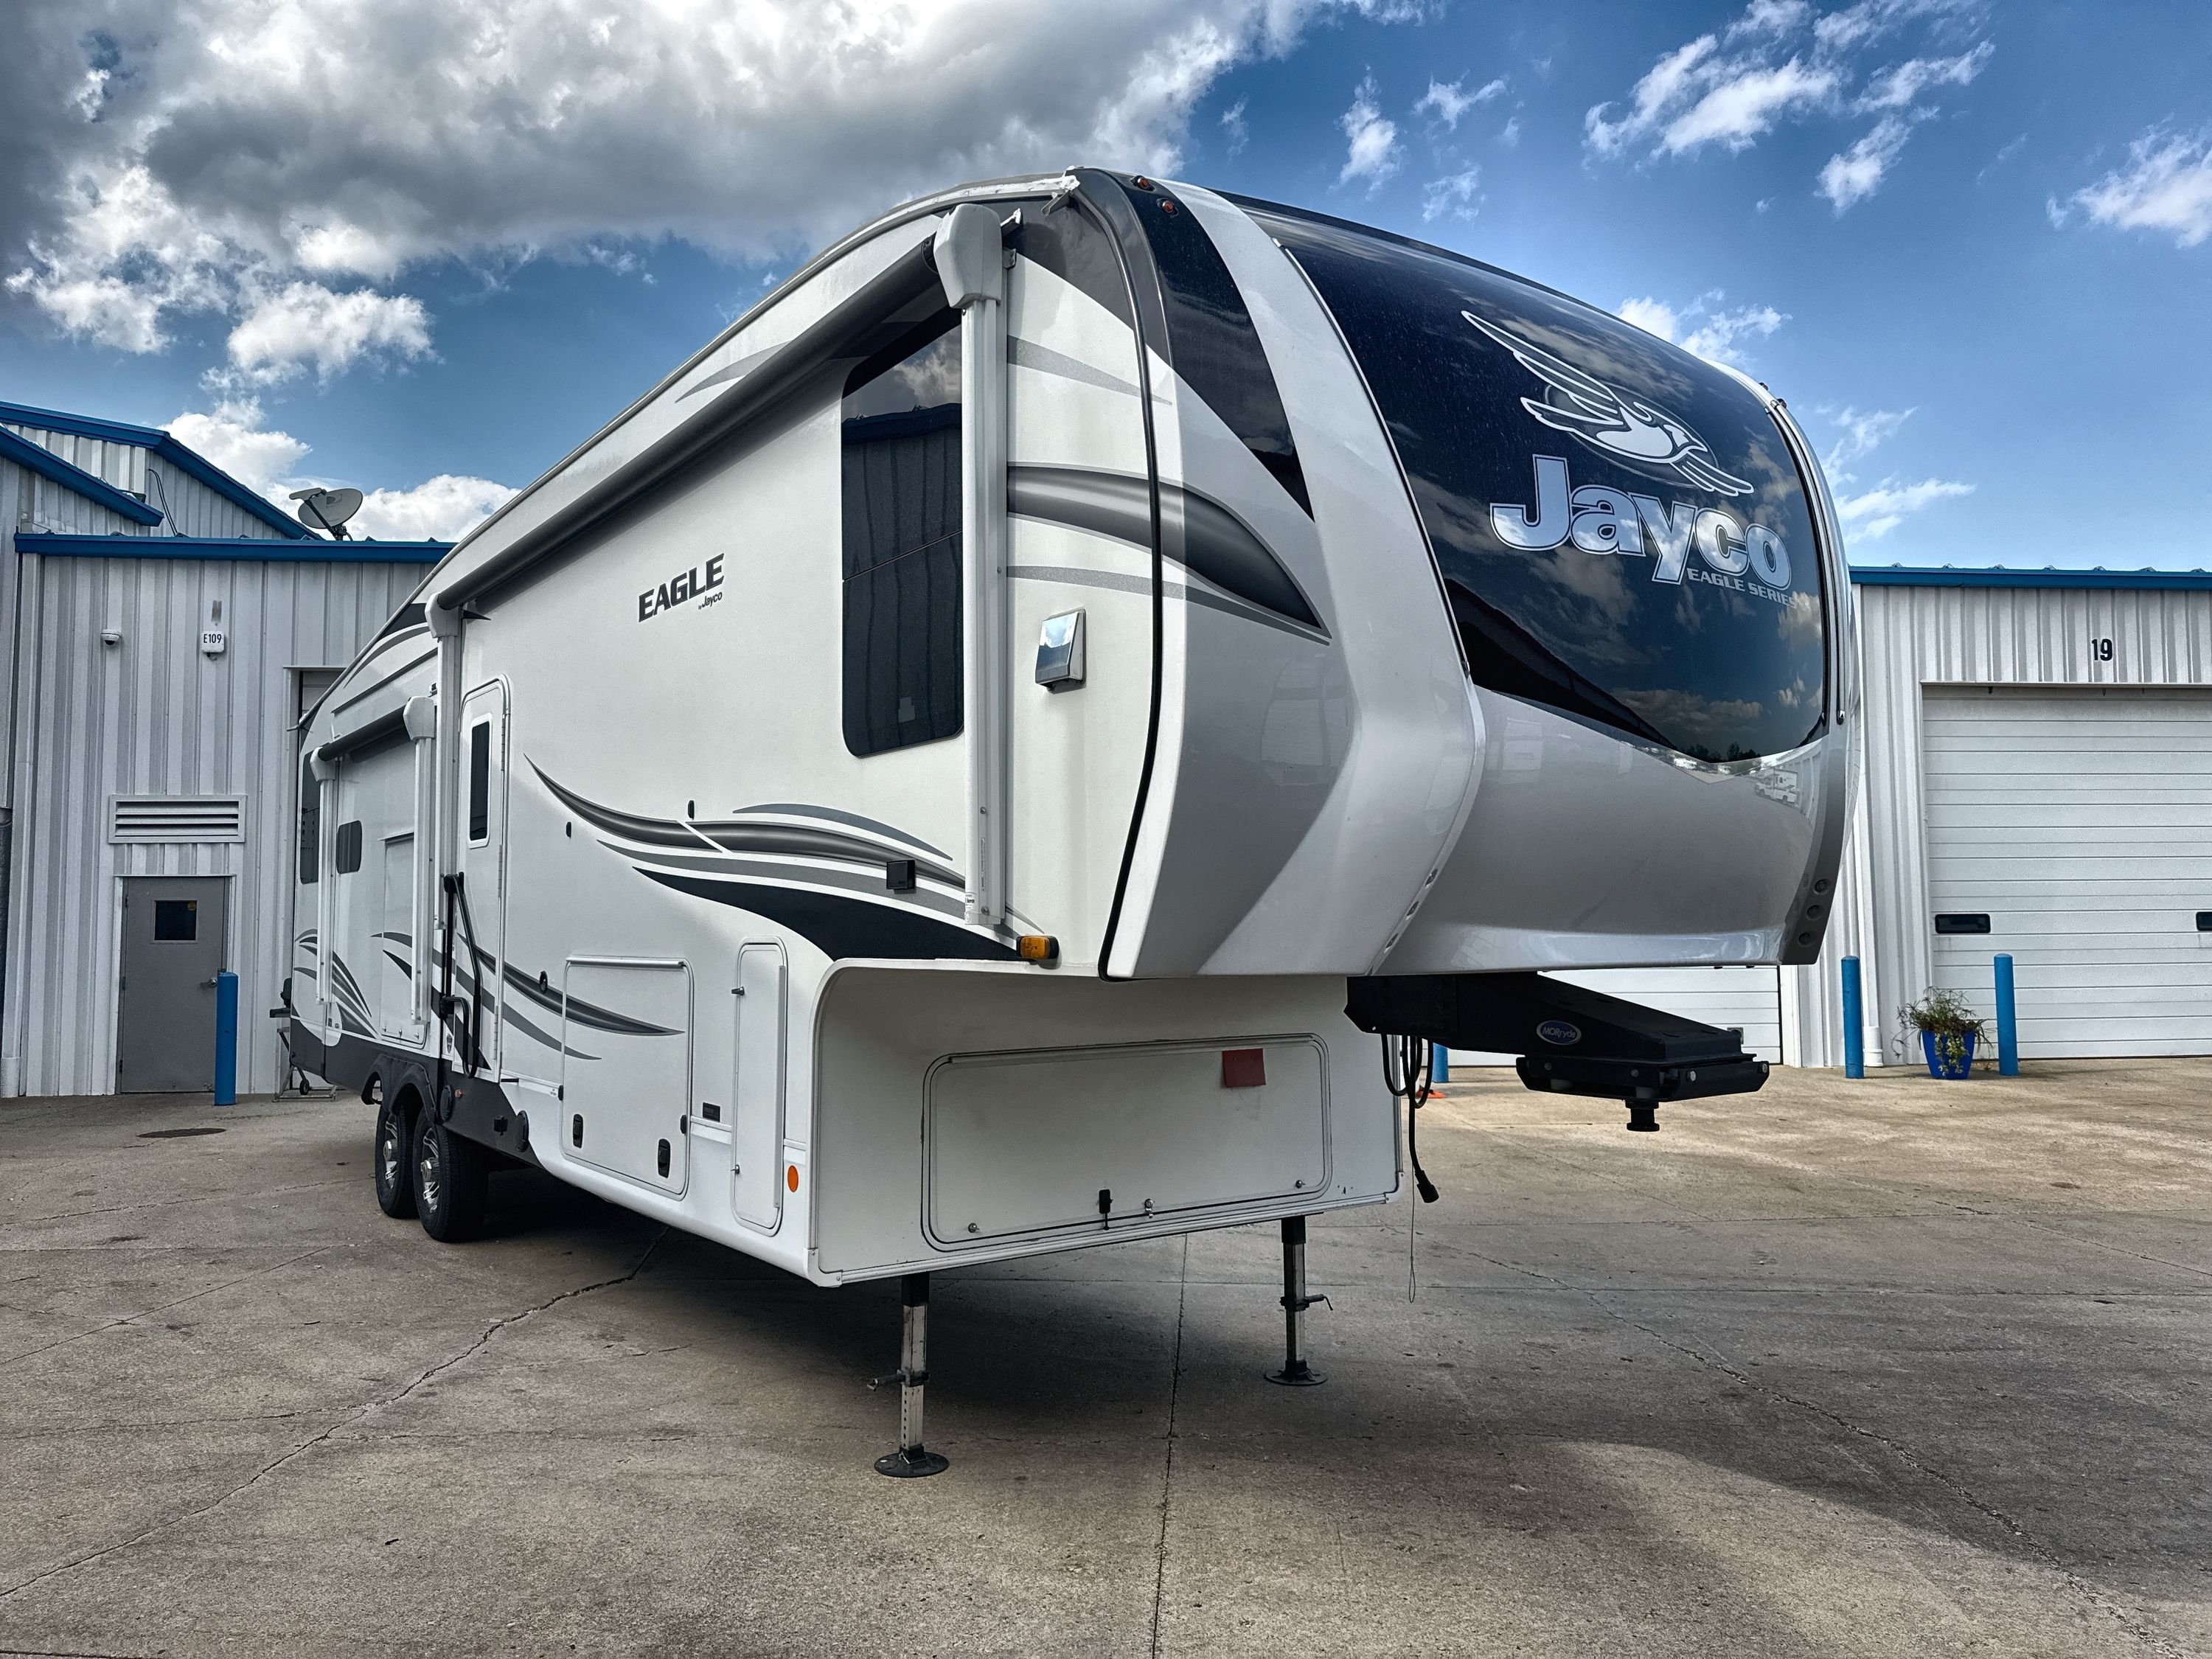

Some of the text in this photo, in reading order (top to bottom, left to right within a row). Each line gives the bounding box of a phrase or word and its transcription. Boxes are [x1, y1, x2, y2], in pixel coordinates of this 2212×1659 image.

[1489, 454, 1792, 591] Jayco
[639, 553, 725, 622] EAGLE
[702, 591, 723, 607] Jayco
[1686, 568, 1797, 609] EAGLE SERIES
[204, 634, 222, 644] E109
[2092, 639, 2113, 661] 19
